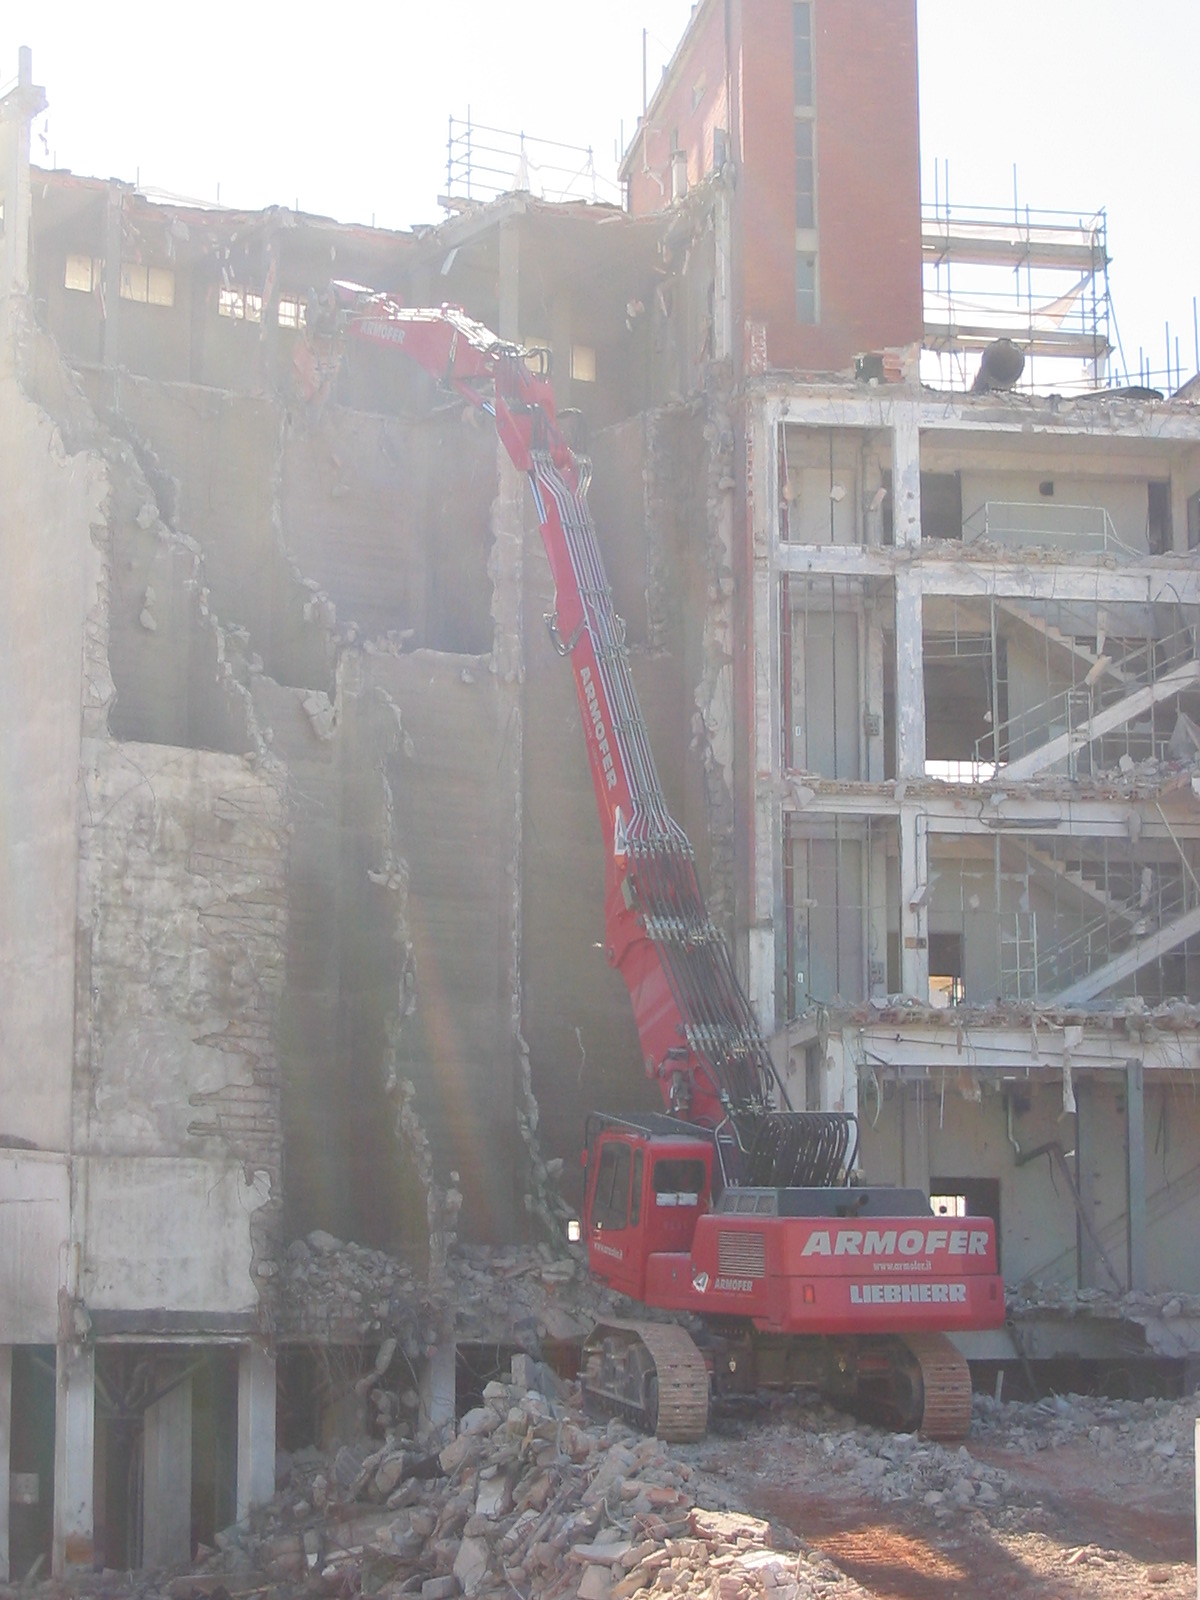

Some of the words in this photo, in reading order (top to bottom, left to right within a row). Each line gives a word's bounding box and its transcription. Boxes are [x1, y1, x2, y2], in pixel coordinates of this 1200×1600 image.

[360, 320, 406, 344] ARMOFER
[580, 666, 617, 791] ARMOFER
[801, 1230, 989, 1256] ARMOFER
[714, 1278, 753, 1292] ARMOFER
[850, 1284, 966, 1303] LIEBHERR
